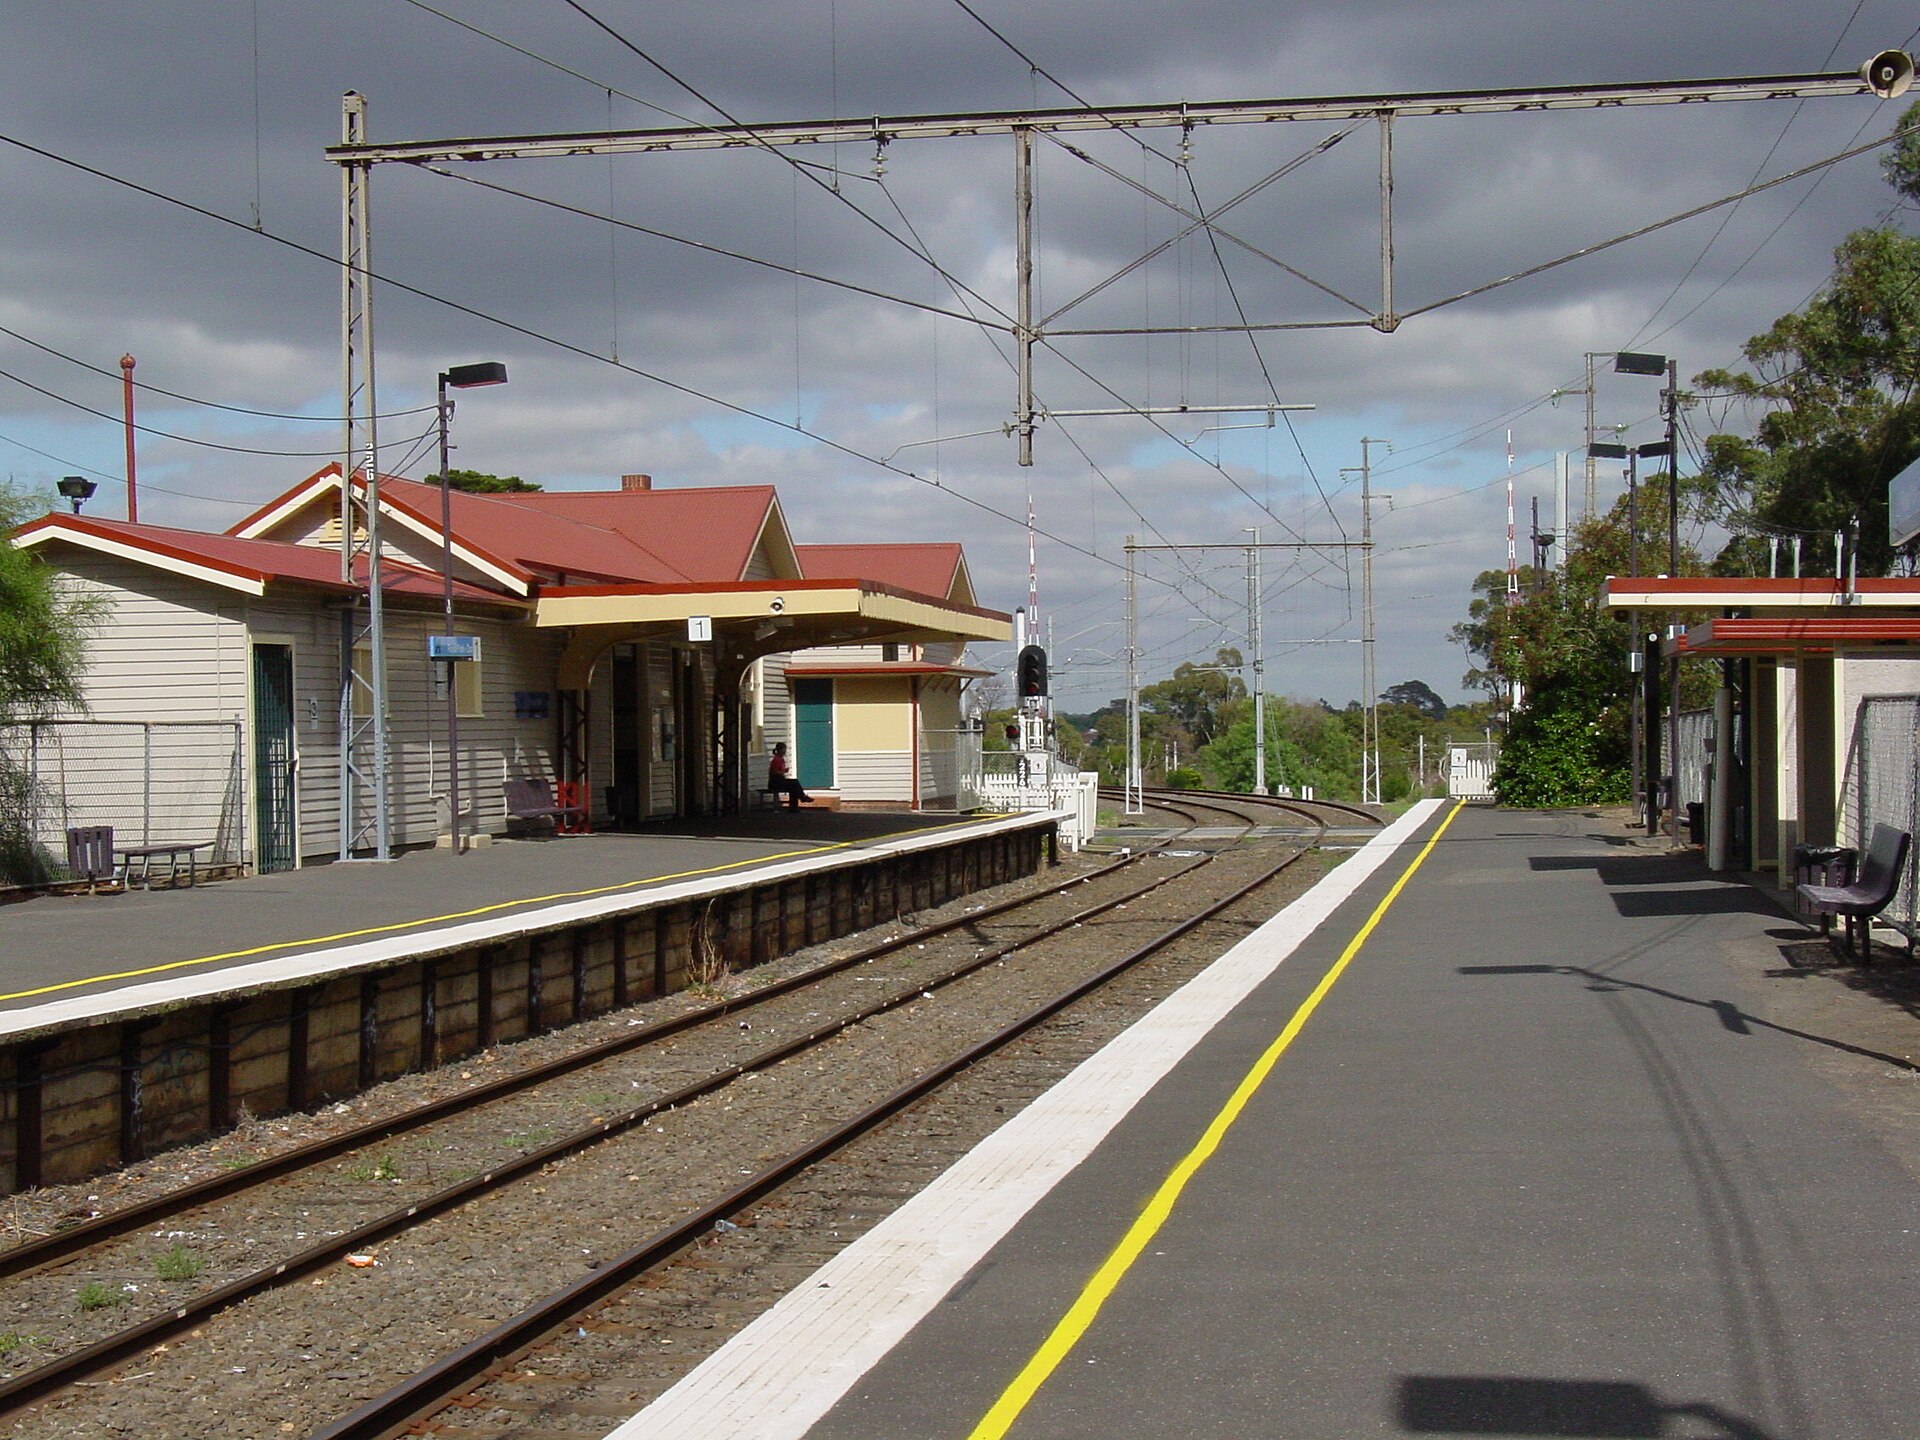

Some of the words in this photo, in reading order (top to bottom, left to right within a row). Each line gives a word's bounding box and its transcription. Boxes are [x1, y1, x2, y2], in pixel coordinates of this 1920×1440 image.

[366, 442, 374, 481] 226
[695, 620, 703, 639] 1
[1018, 762, 1026, 786] 226
